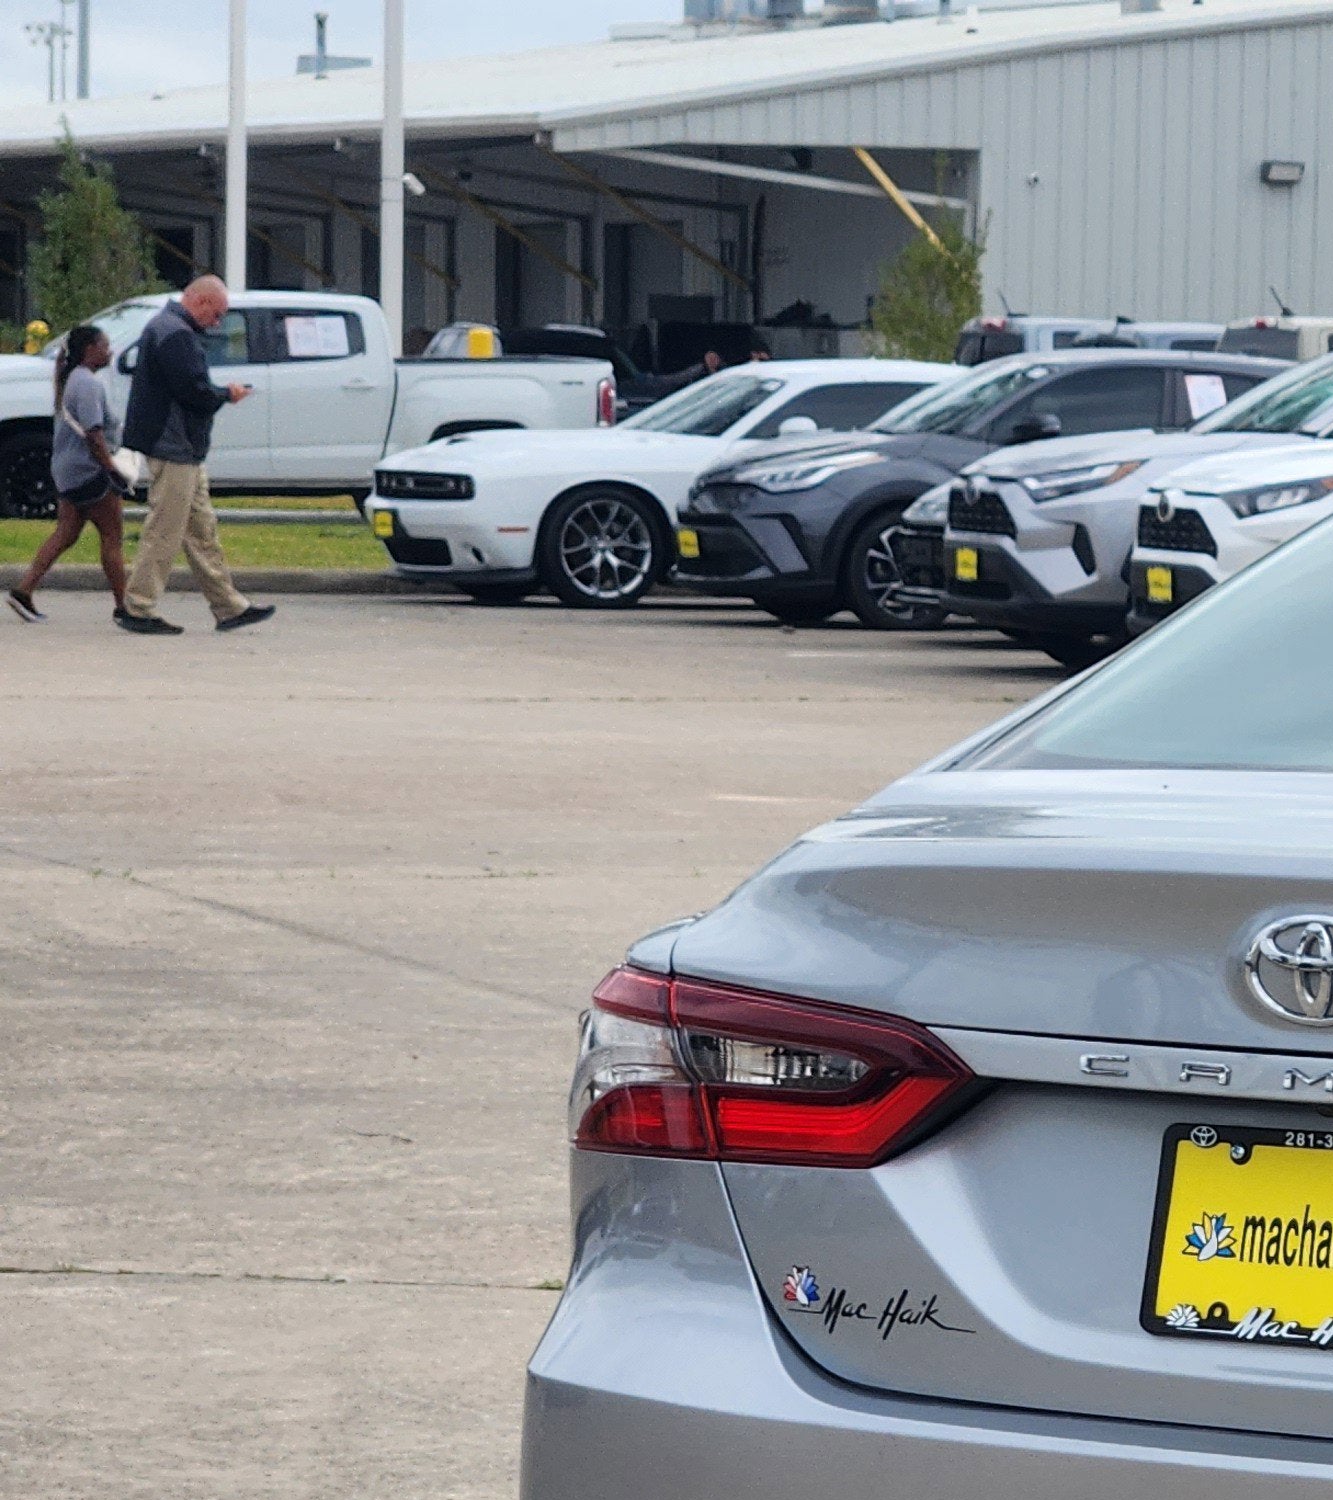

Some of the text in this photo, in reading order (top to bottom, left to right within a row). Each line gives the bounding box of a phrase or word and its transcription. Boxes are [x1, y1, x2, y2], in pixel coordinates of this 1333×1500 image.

[802, 1286, 974, 1341] Mac Haik
[1208, 1306, 1308, 1342] Mac
